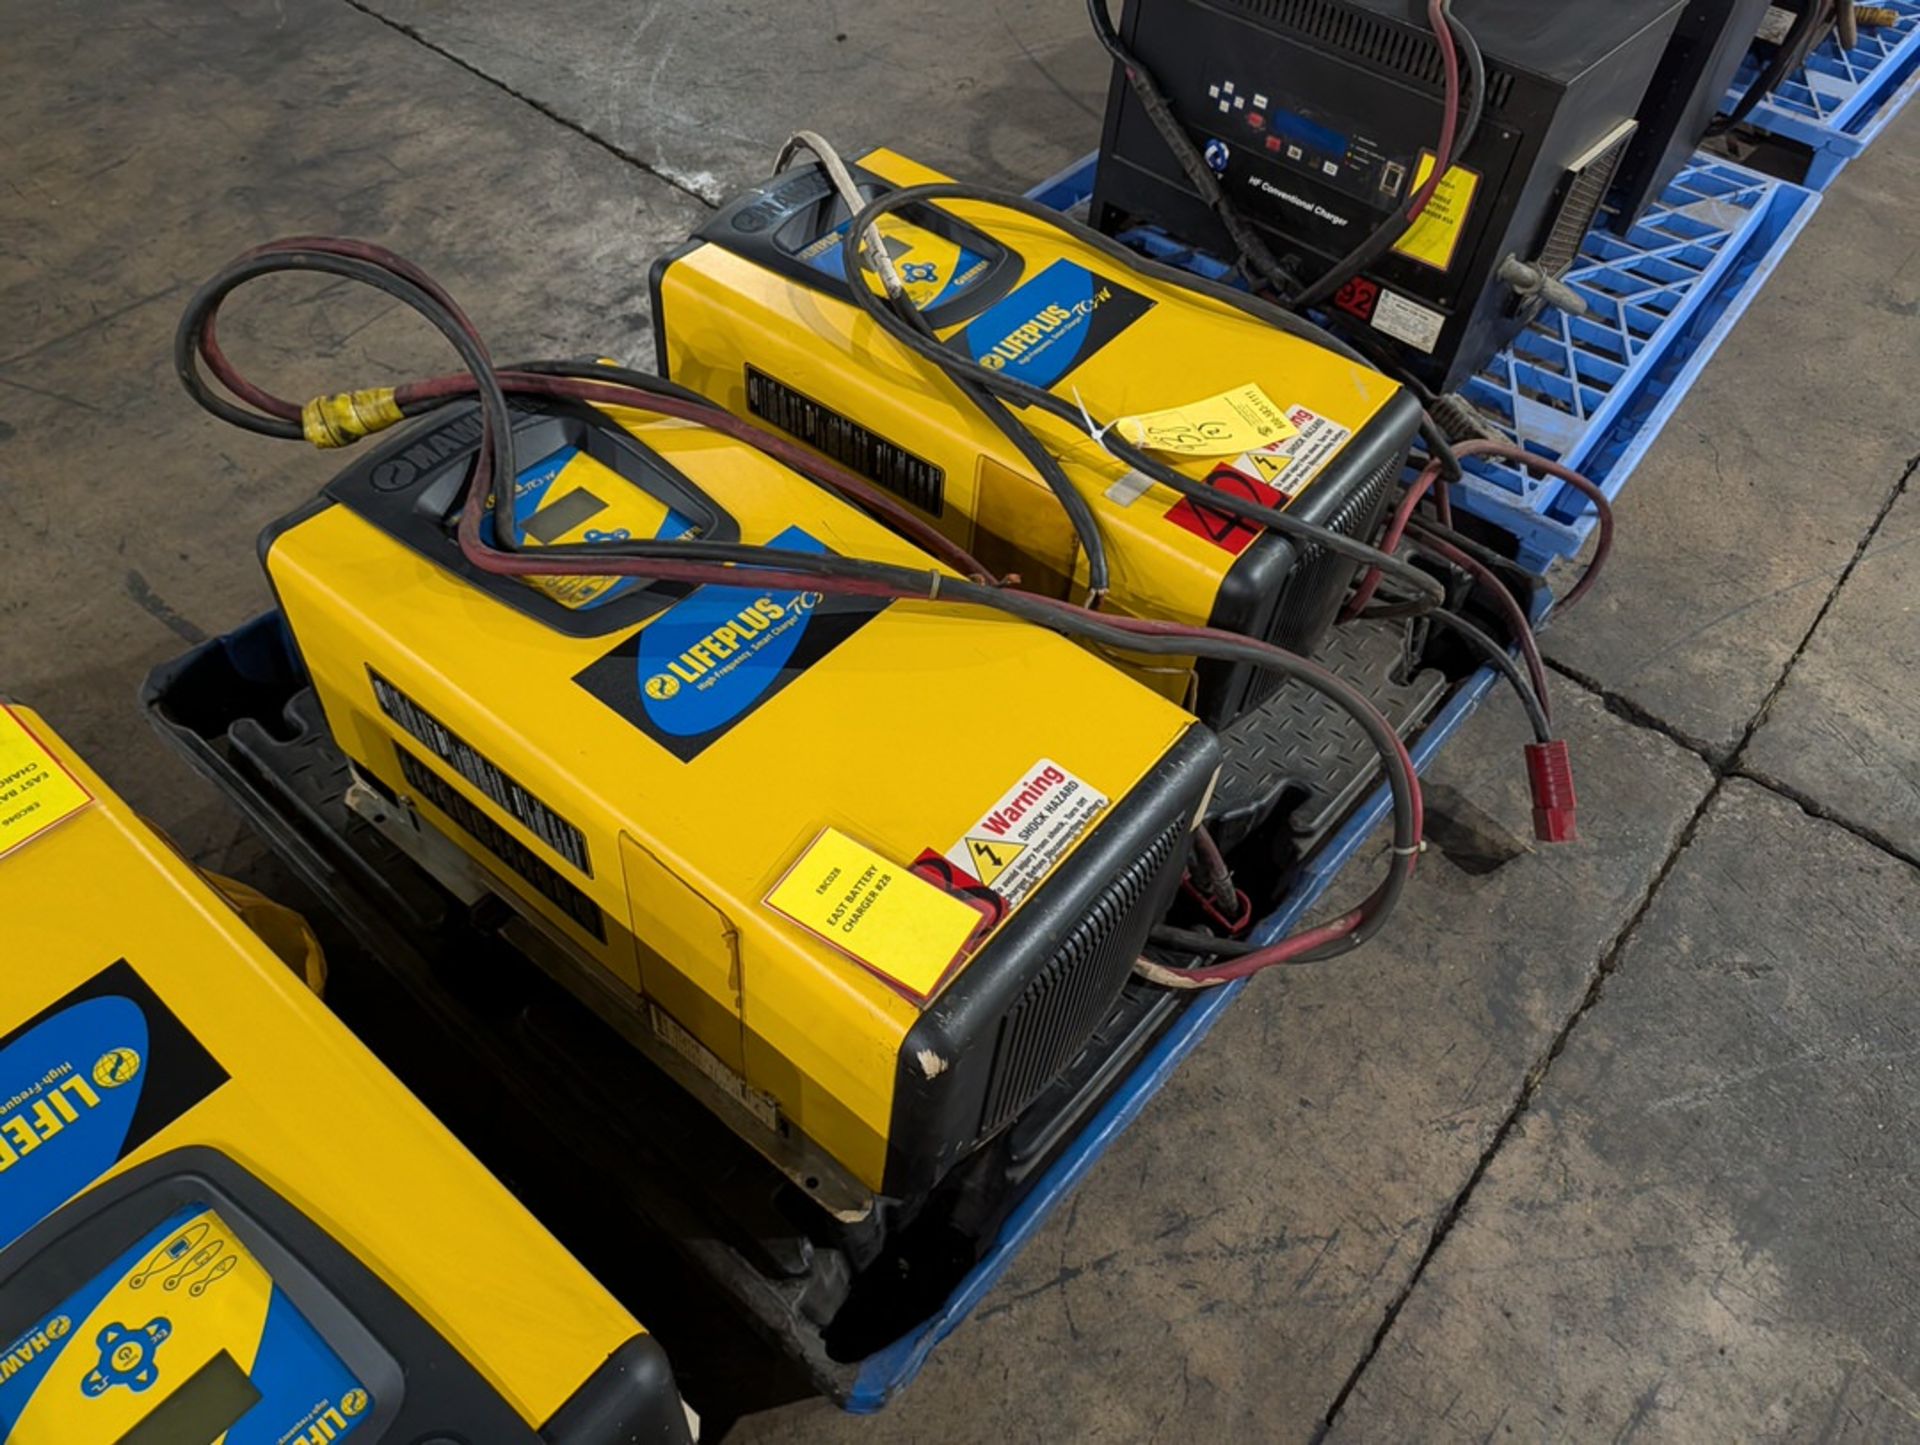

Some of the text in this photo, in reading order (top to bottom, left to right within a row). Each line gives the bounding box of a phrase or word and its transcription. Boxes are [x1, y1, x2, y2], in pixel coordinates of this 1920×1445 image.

[1248, 176, 1348, 227] HF Conventional Charger
[992, 304, 1071, 360] LIFEPLUS
[667, 597, 785, 684] LIFEPLUS
[751, 633, 774, 651] Smart
[772, 615, 799, 636] Charger
[20, 770, 49, 792] EAST
[981, 765, 1065, 837] Warning
[1018, 780, 1079, 841] SHOCK HAZARD
[826, 864, 878, 926] EAST BATTERY
[842, 874, 891, 933] CHARGER #28
[0, 1331, 50, 1384] HAW
